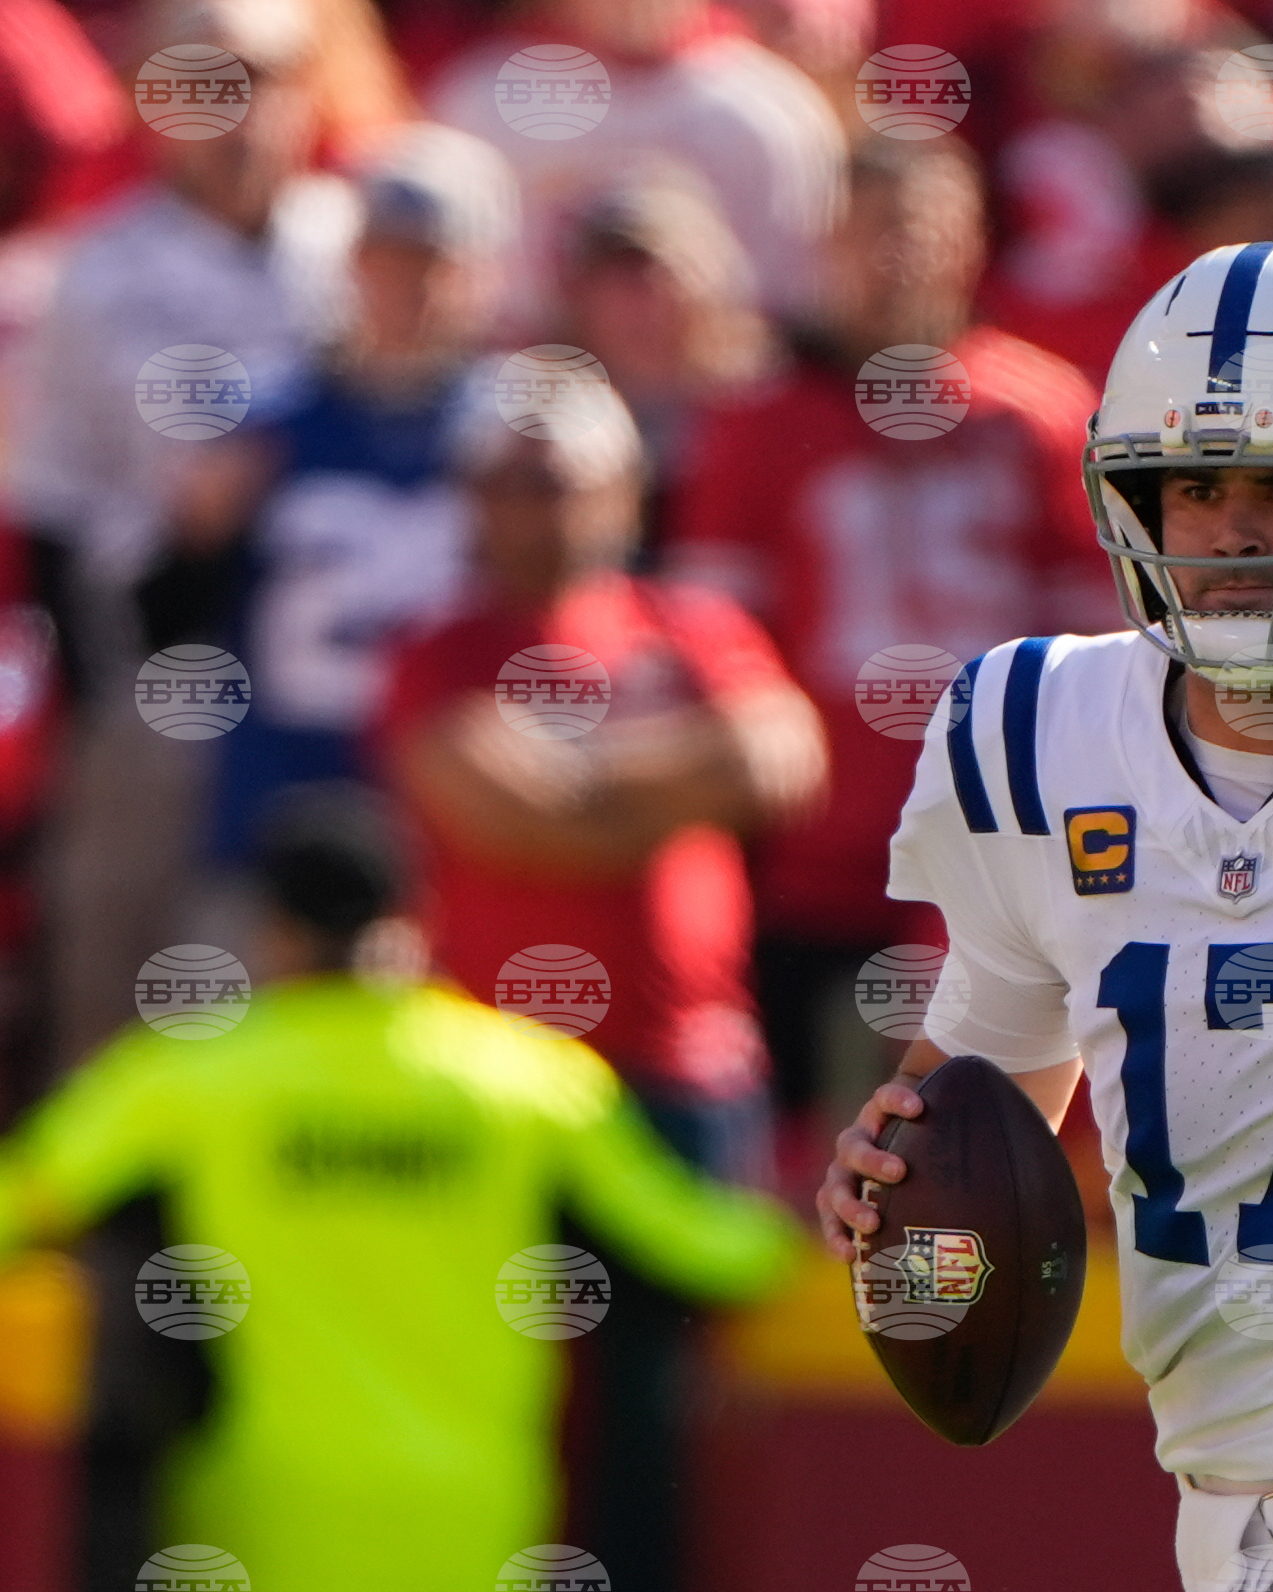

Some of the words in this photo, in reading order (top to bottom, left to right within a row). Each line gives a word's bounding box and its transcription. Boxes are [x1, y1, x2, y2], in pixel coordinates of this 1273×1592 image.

[1068, 811, 1129, 872] C
[1222, 871, 1251, 892] NFL
[936, 1238, 981, 1297] NFL
